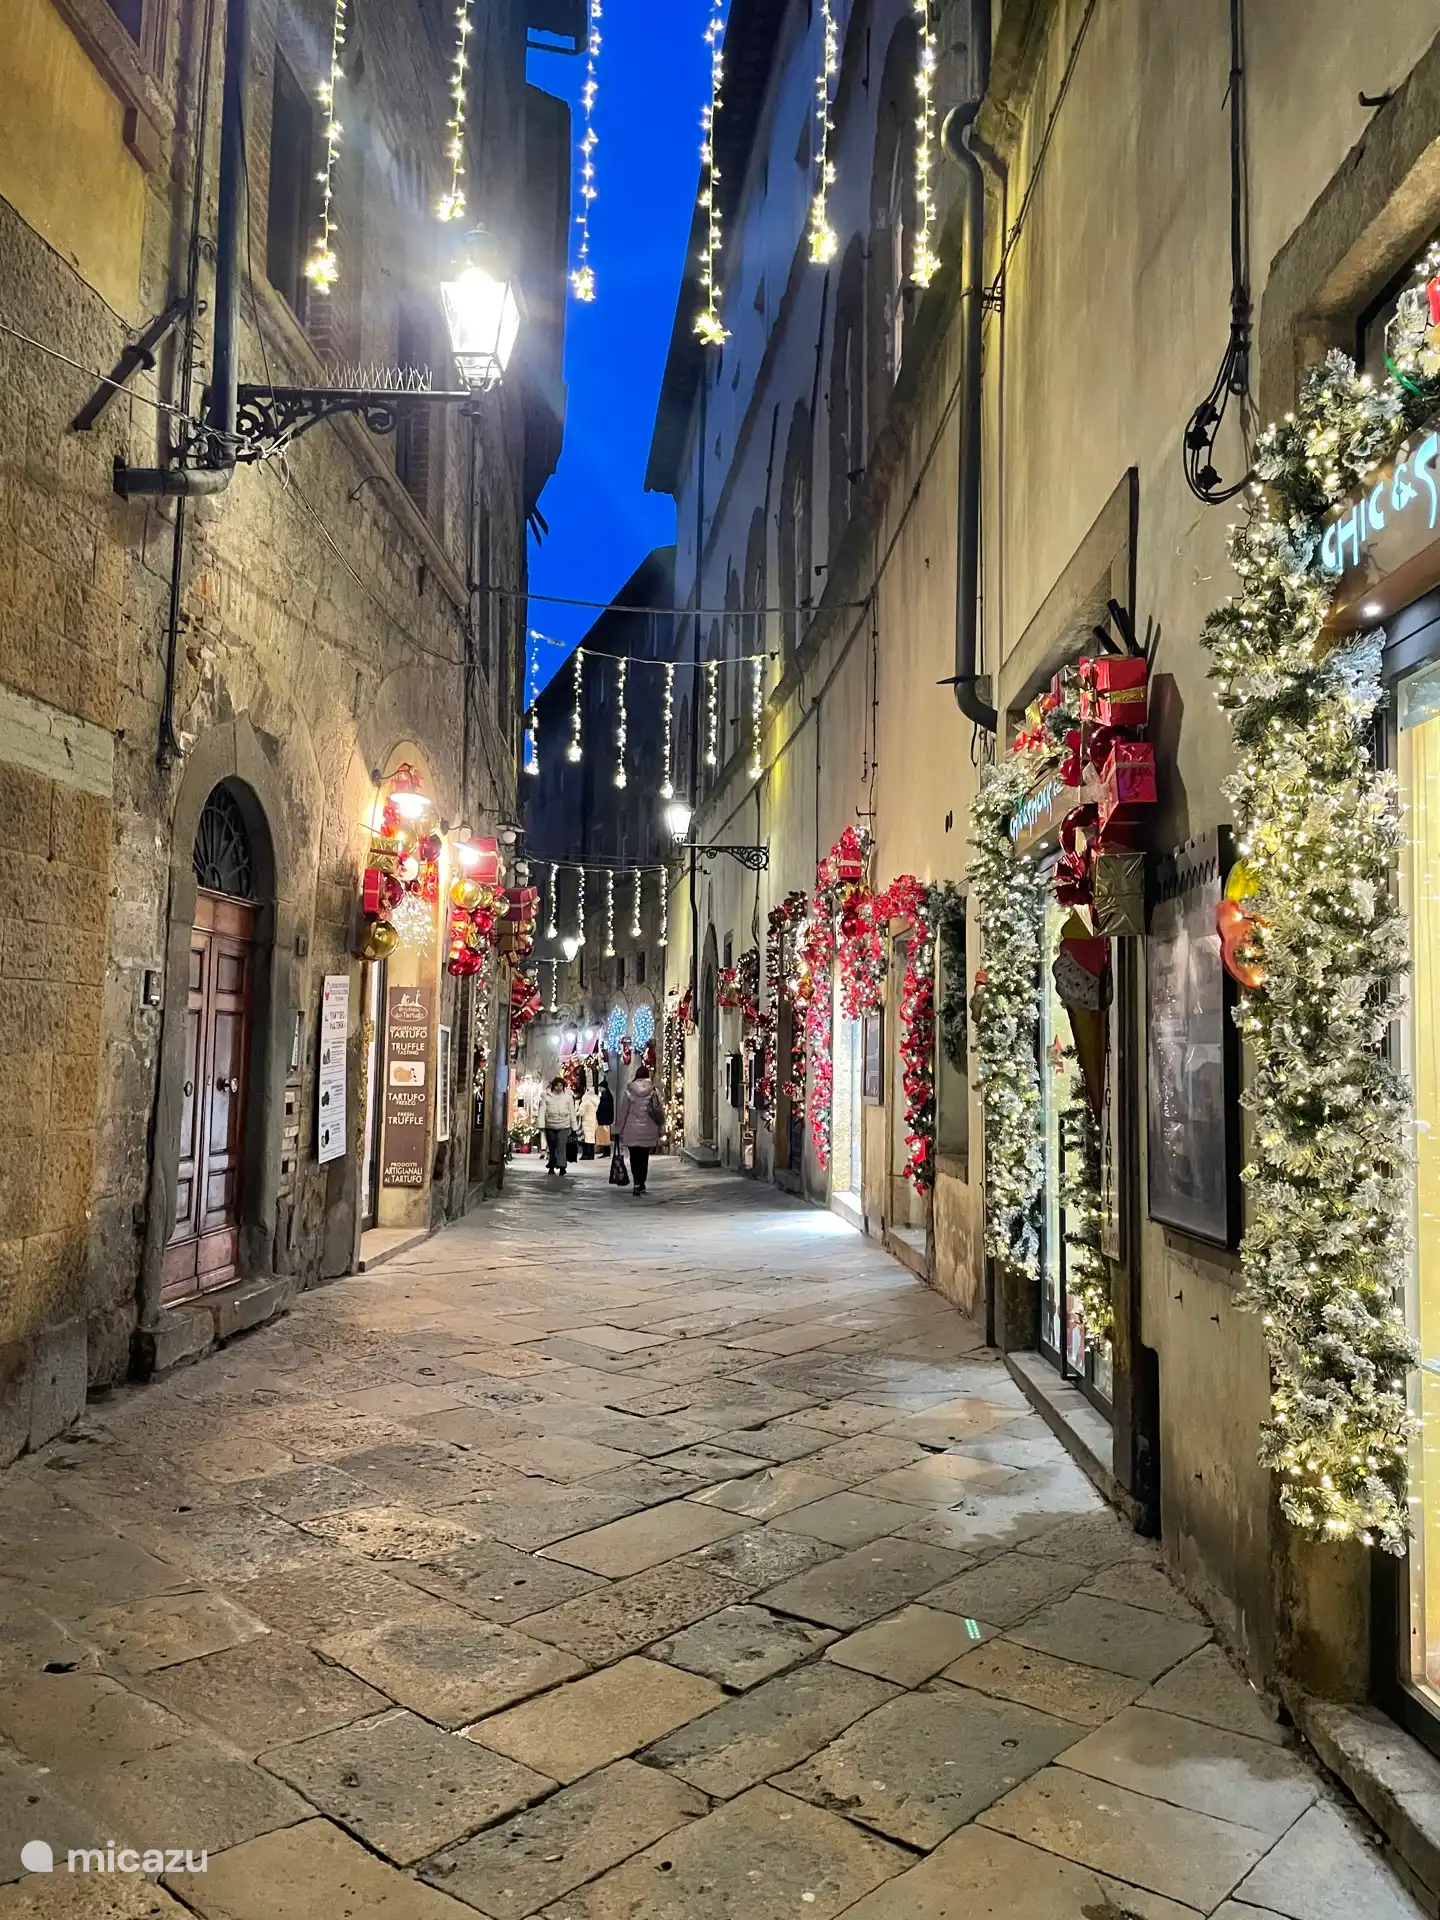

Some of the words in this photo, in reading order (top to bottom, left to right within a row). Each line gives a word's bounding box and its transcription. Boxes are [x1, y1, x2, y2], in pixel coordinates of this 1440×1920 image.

[390, 1030, 428, 1039] TARTUFO
[391, 1042, 425, 1051] TRUFFLE
[388, 1092, 426, 1102] TARTUFO
[388, 1116, 424, 1125] TRUFFLE
[384, 1166, 423, 1175] ARTIGIANALI
[391, 1175, 423, 1183] TARTUFO
